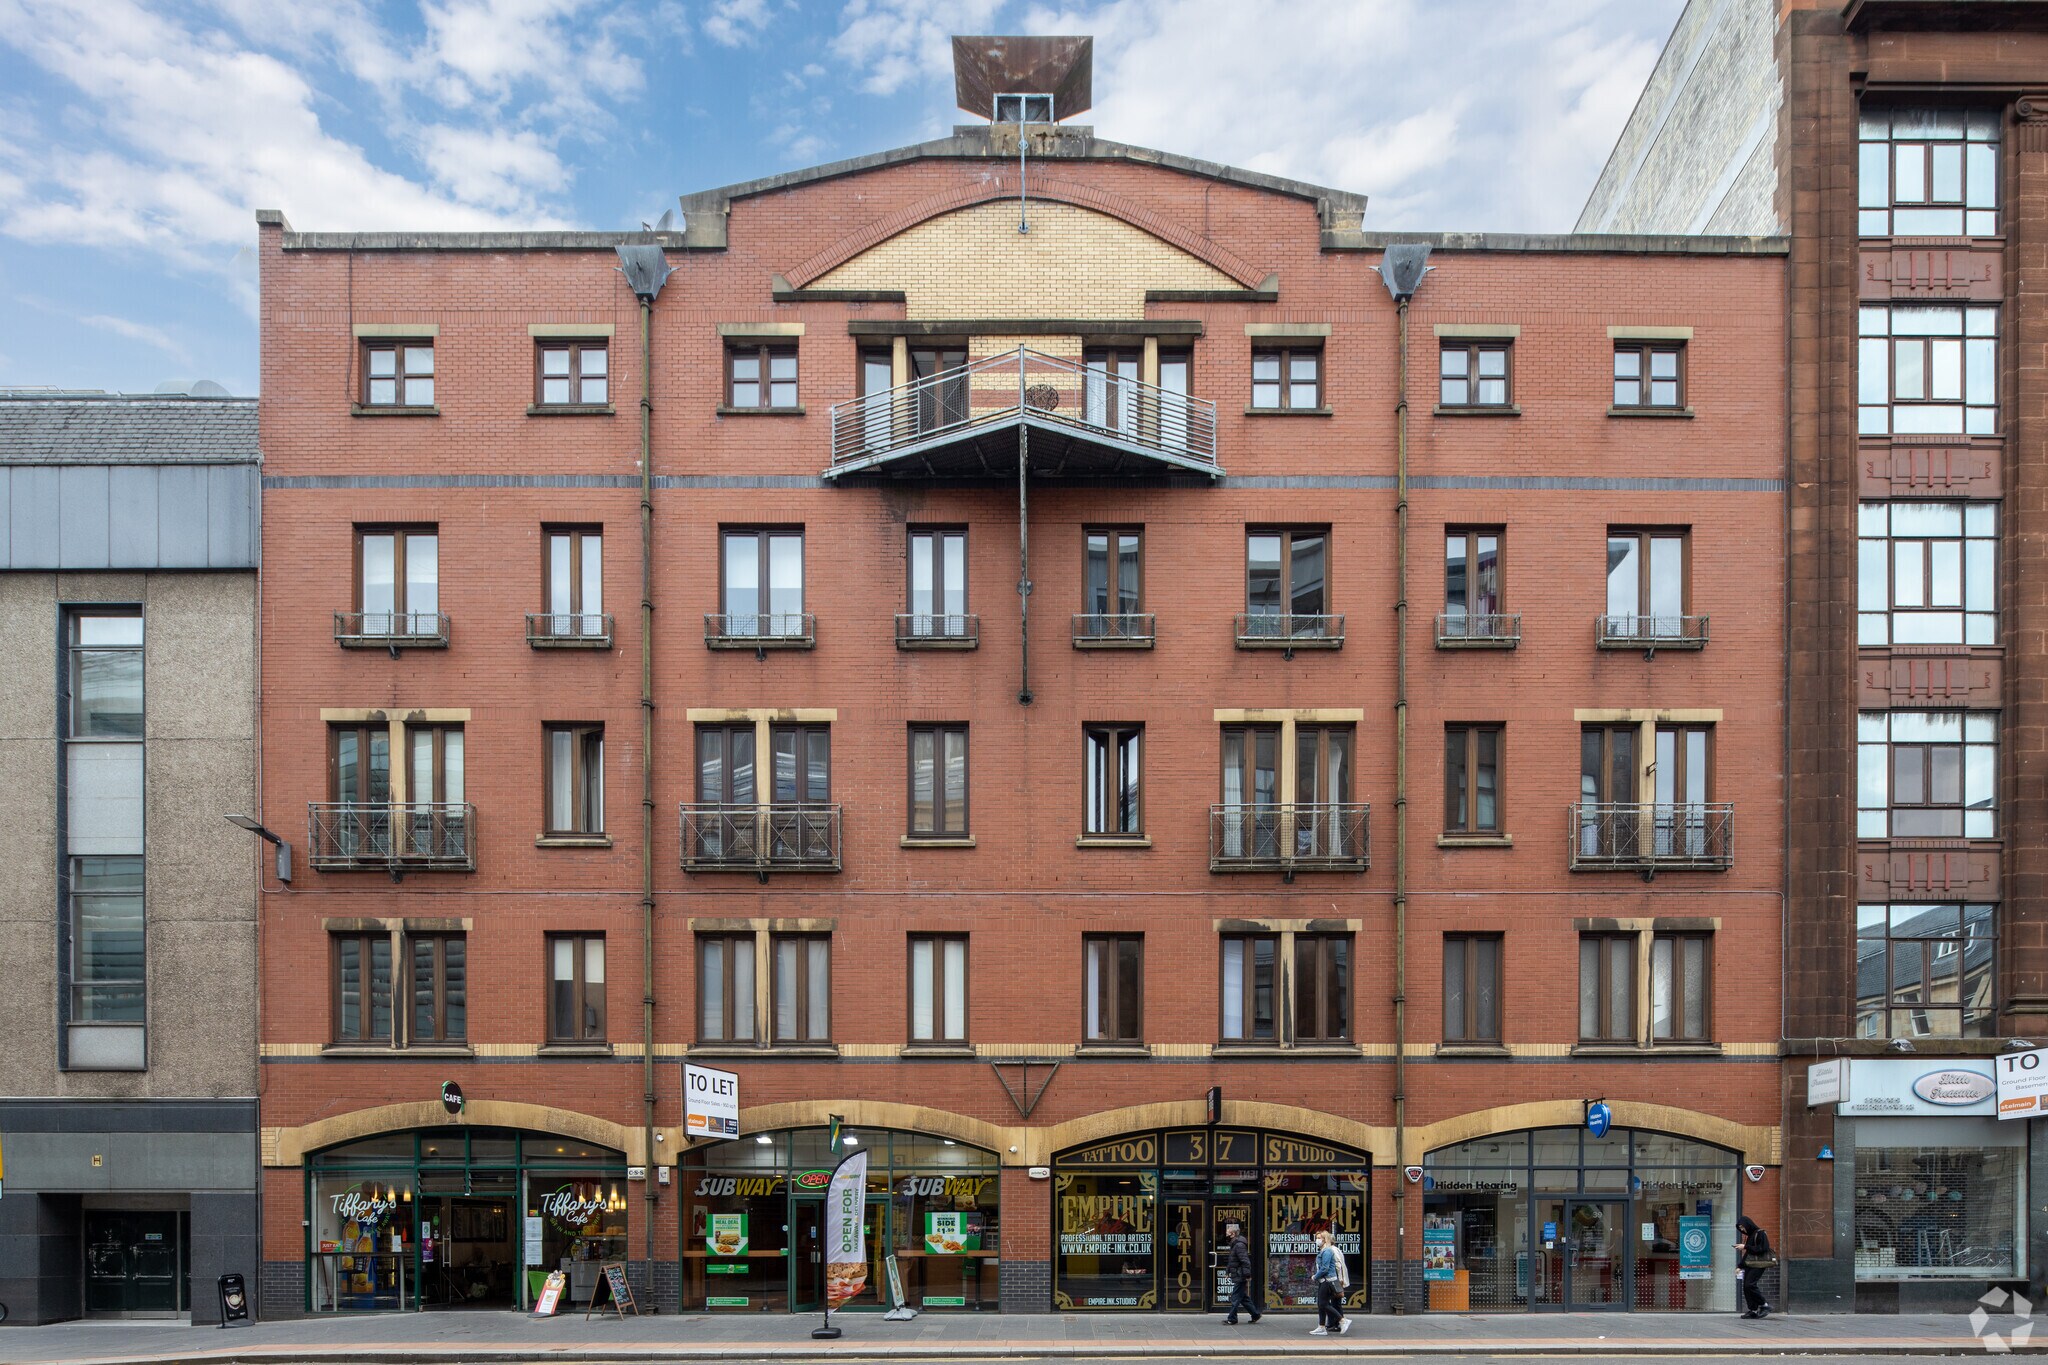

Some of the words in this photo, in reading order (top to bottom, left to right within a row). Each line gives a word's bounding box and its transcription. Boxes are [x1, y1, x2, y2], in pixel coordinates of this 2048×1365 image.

[2003, 1053, 2040, 1073] TO
[688, 1072, 708, 1092] TO
[712, 1077, 734, 1096] LET
[2001, 1077, 2027, 1086] Ground
[444, 1093, 462, 1104] CAFE
[1081, 1139, 1154, 1162] TATTOO
[1268, 1138, 1336, 1163] STUDIO
[694, 1178, 785, 1196] SUBWAY
[801, 1174, 829, 1184] OPEN
[903, 1178, 993, 1197] SUBWAY
[1435, 1181, 1473, 1190] Hidden
[1475, 1181, 1517, 1191] Hearing
[1641, 1180, 1679, 1190] Hidden
[1681, 1181, 1723, 1191] Hearing
[330, 1192, 397, 1218] Tiffany's
[541, 1191, 608, 1217] Tiffany's
[842, 1188, 852, 1215] FOR
[356, 1210, 379, 1226] Cafe
[566, 1210, 589, 1226] Cafe
[1061, 1195, 1152, 1233] EMPIRE
[1217, 1209, 1247, 1222] EMPIRE
[1270, 1195, 1360, 1233] EMPIRE
[1592, 1211, 1603, 1219] 39
[842, 1217, 852, 1253] OPEN
[1104, 1233, 1126, 1242] TATTOO
[1127, 1233, 1152, 1242] ARTISTS
[1336, 1233, 1361, 1242] ARTISTS
[1061, 1243, 1152, 1253] WWW.EMPIRE-INK.CO.UK
[1177, 1205, 1192, 1305] TATTOO
